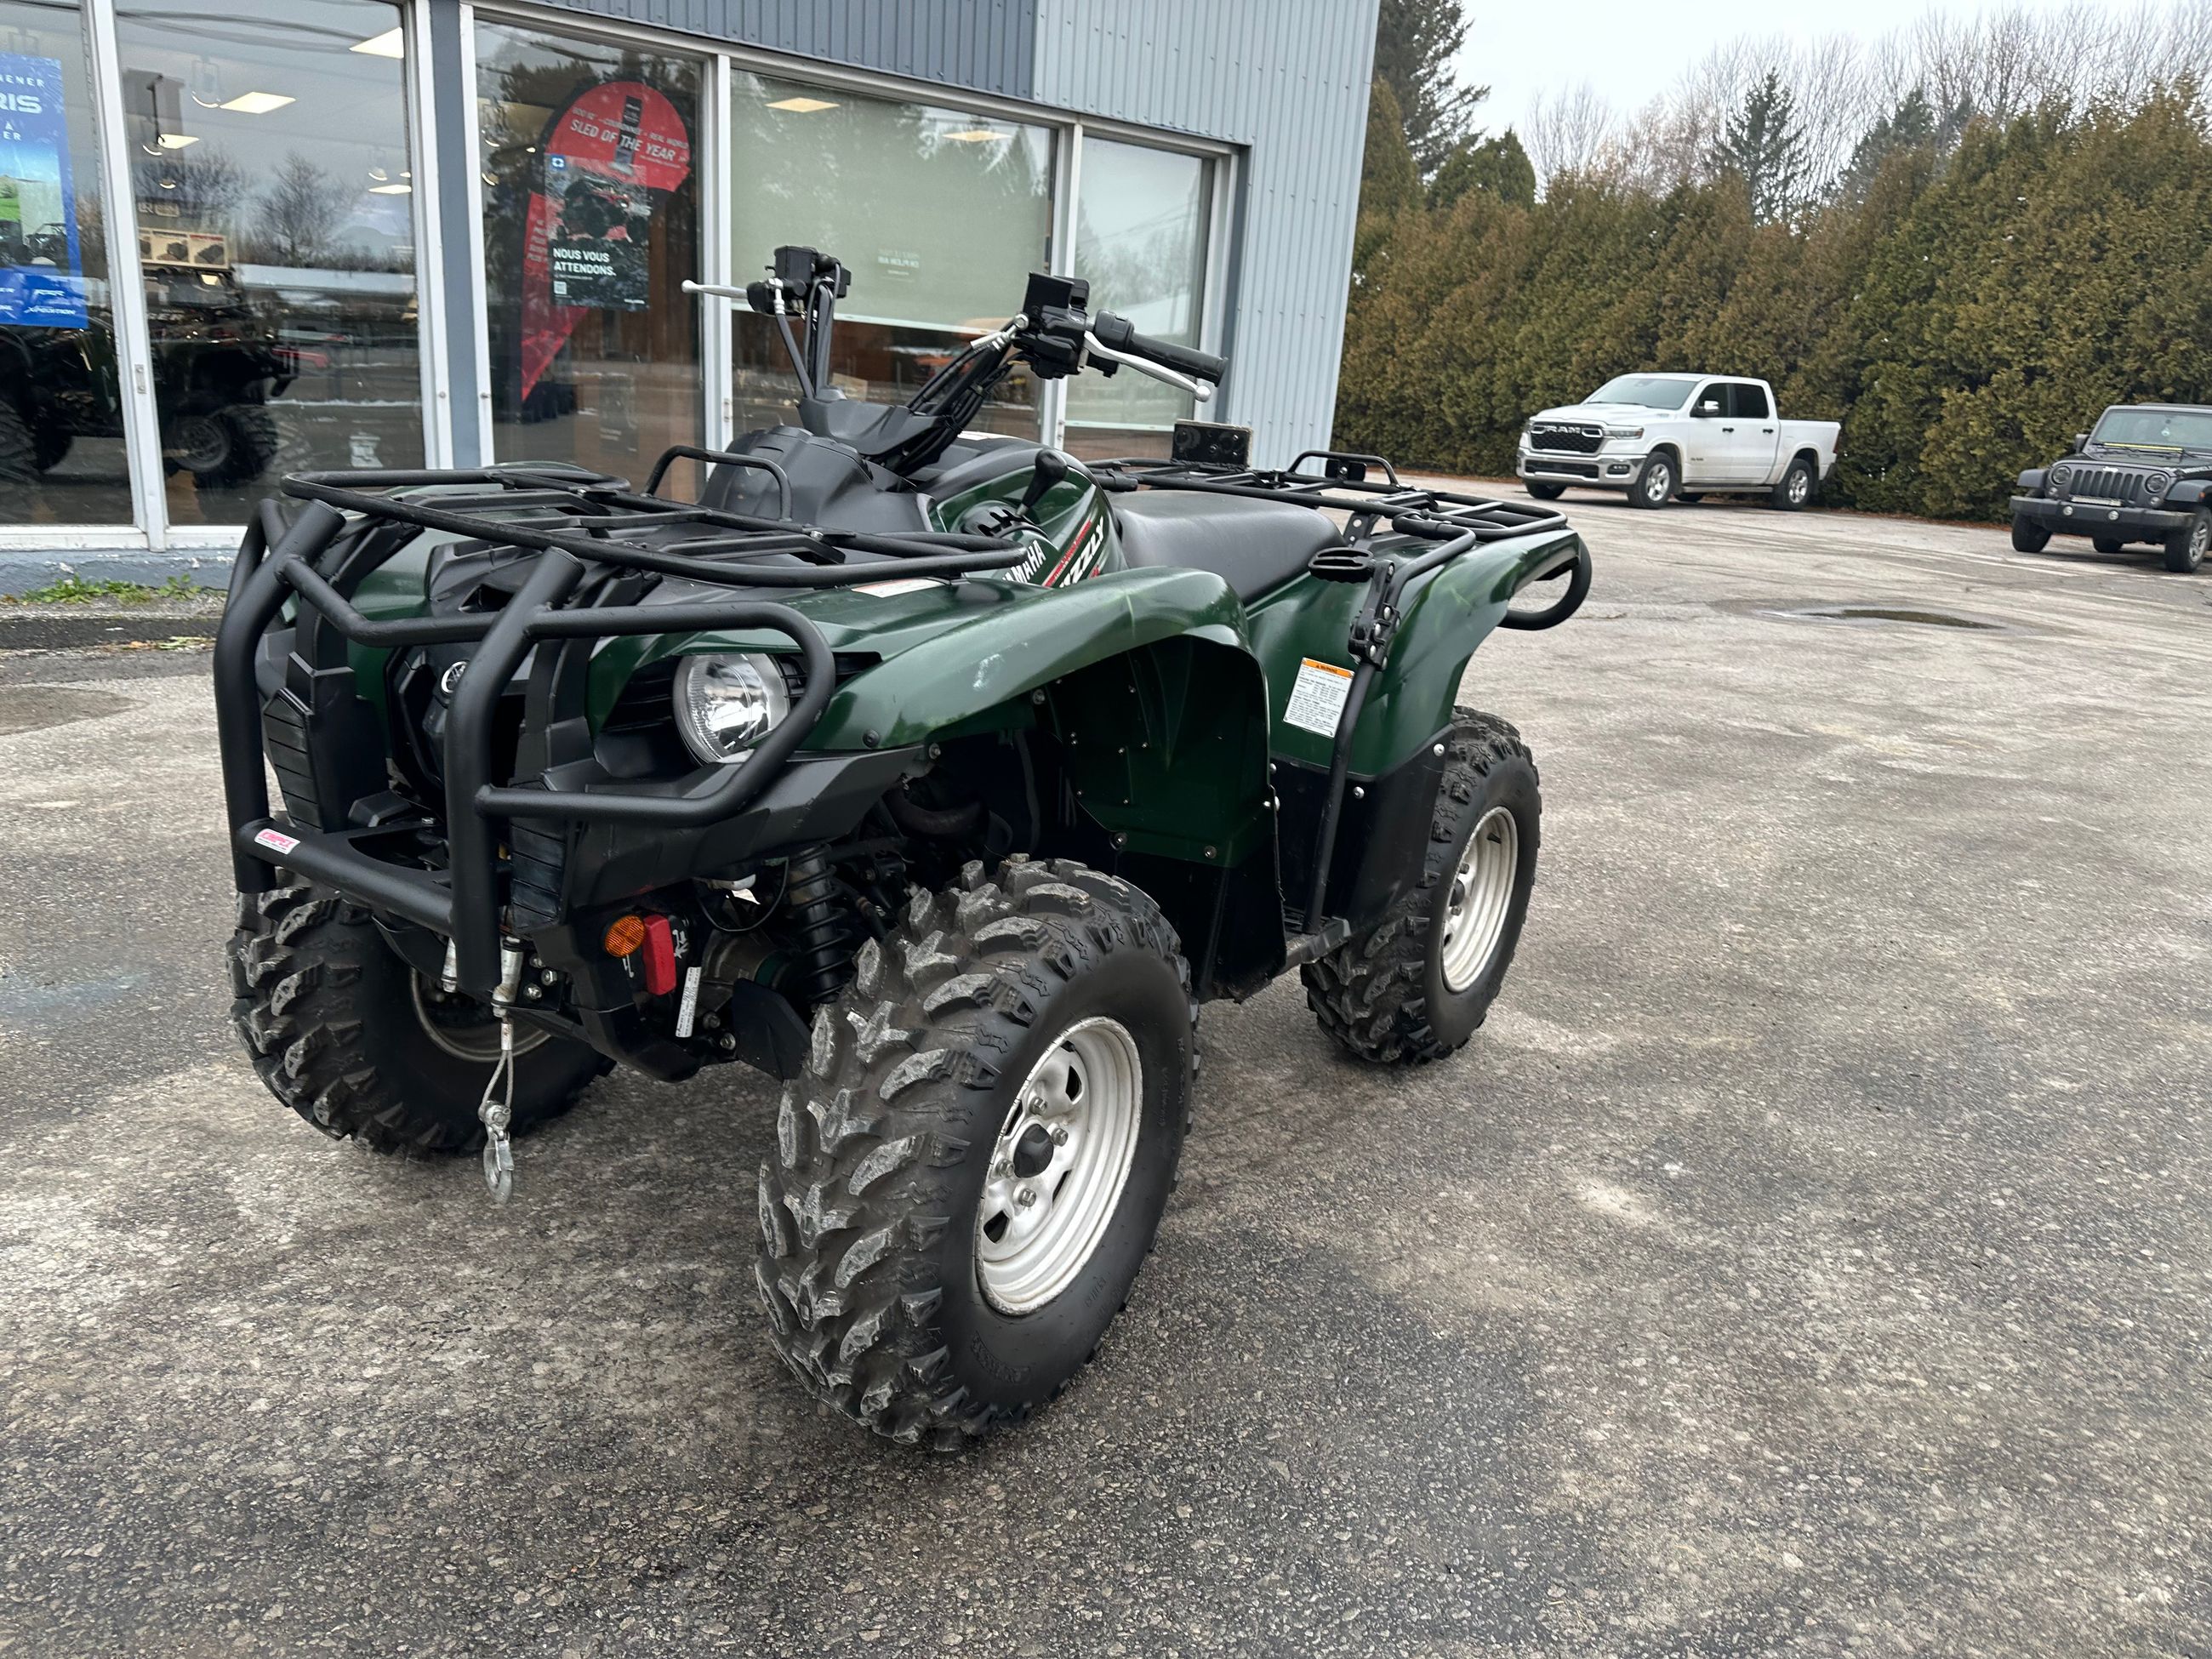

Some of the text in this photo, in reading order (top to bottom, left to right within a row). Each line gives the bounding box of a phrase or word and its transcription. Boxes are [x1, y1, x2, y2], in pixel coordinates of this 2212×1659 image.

[570, 119, 599, 138] SLED
[601, 129, 619, 143] OF
[620, 134, 643, 151] THE
[646, 142, 676, 162] YEAR
[553, 248, 610, 263] NOUS VOUS
[554, 261, 617, 276] ATTENDONS.
[1545, 425, 1581, 434] RAM
